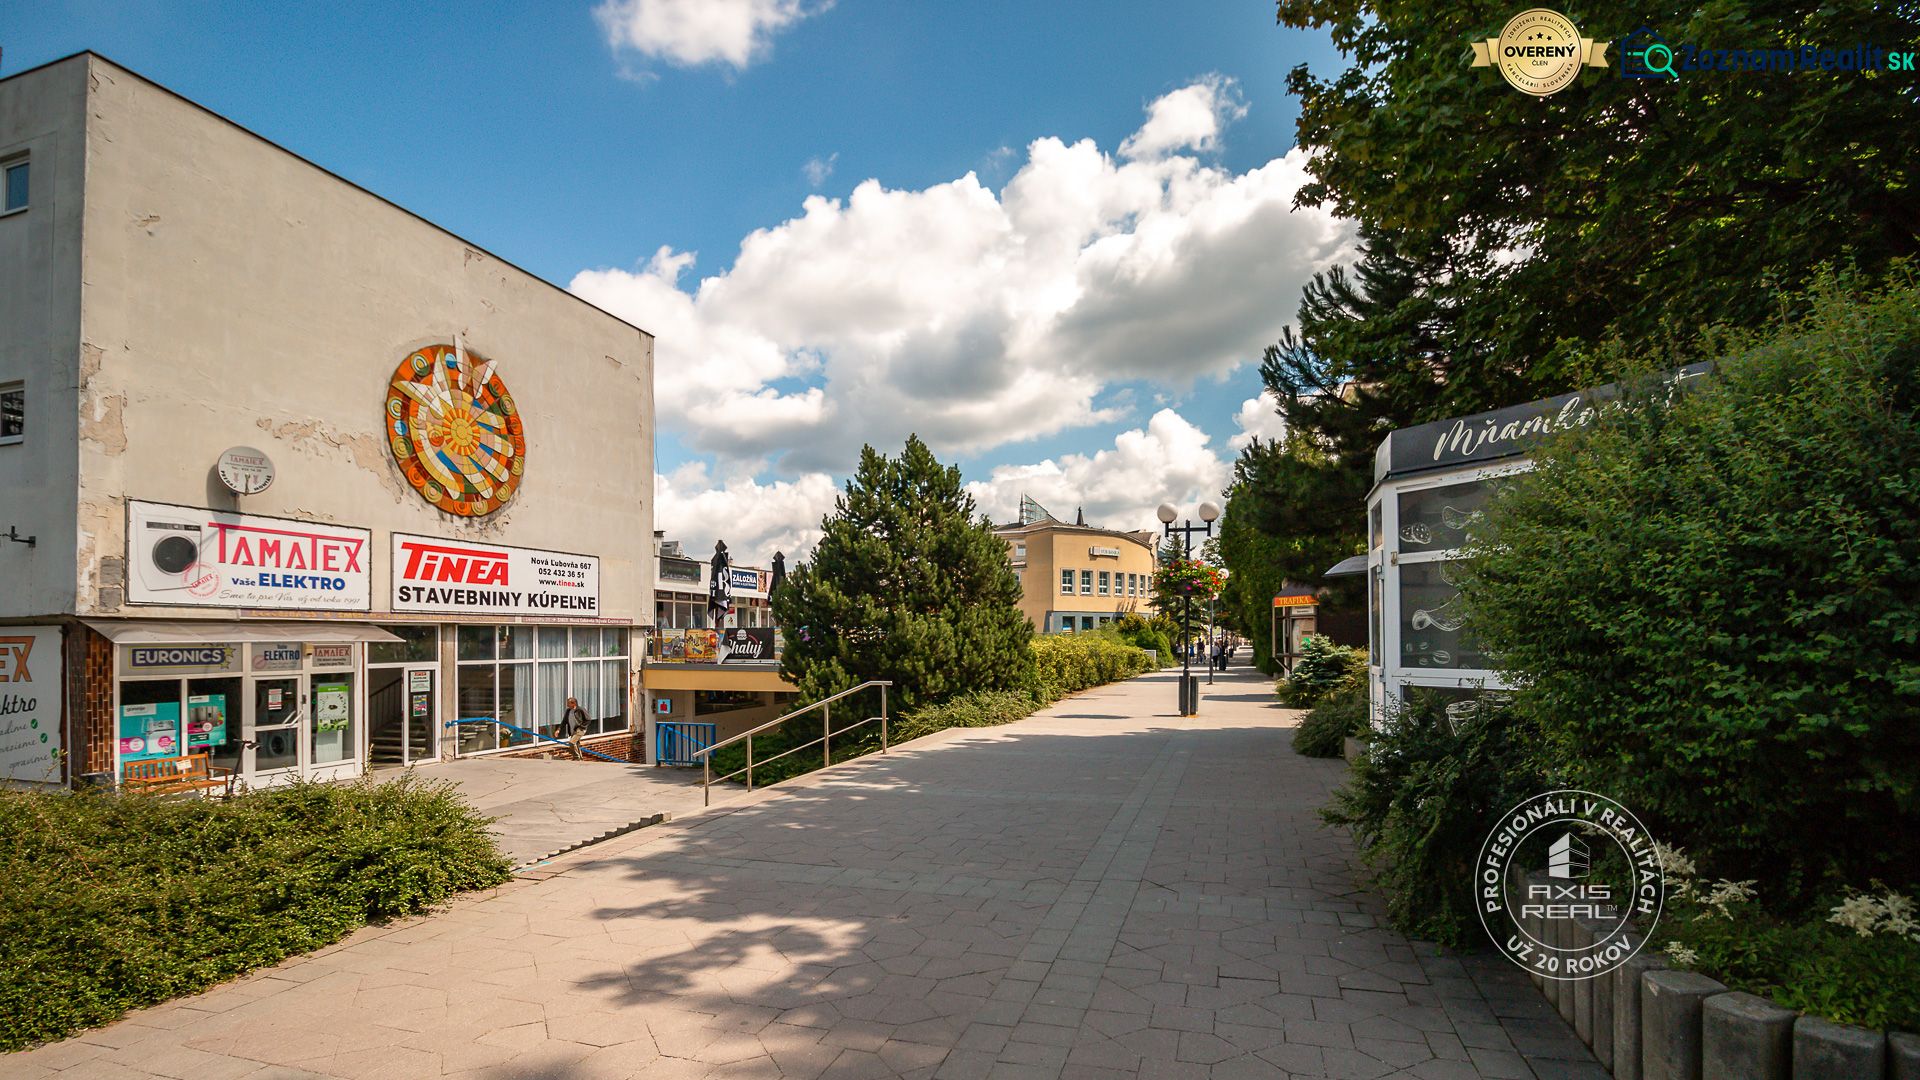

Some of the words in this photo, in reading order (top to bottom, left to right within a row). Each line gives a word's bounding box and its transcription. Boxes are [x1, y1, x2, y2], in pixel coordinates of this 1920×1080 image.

[208, 521, 364, 573] TAMATEX
[531, 557, 548, 566] Nová
[550, 559, 578, 569] Ľubovňa
[579, 562, 592, 570] 667
[538, 567, 552, 576] 052
[552, 569, 566, 577] 432
[567, 570, 576, 578] 36
[576, 571, 585, 579] 51
[231, 577, 256, 587] Vaše
[258, 572, 346, 591] ELEKTRO
[538, 579, 585, 588] www.tinea.sk
[398, 585, 522, 608] STAVEBNINY
[527, 590, 596, 610] KÚPEĽNE
[1279, 597, 1309, 605] TRAFIKA
[135, 650, 222, 664] EURONICS
[264, 650, 300, 660] ELEKTRO
